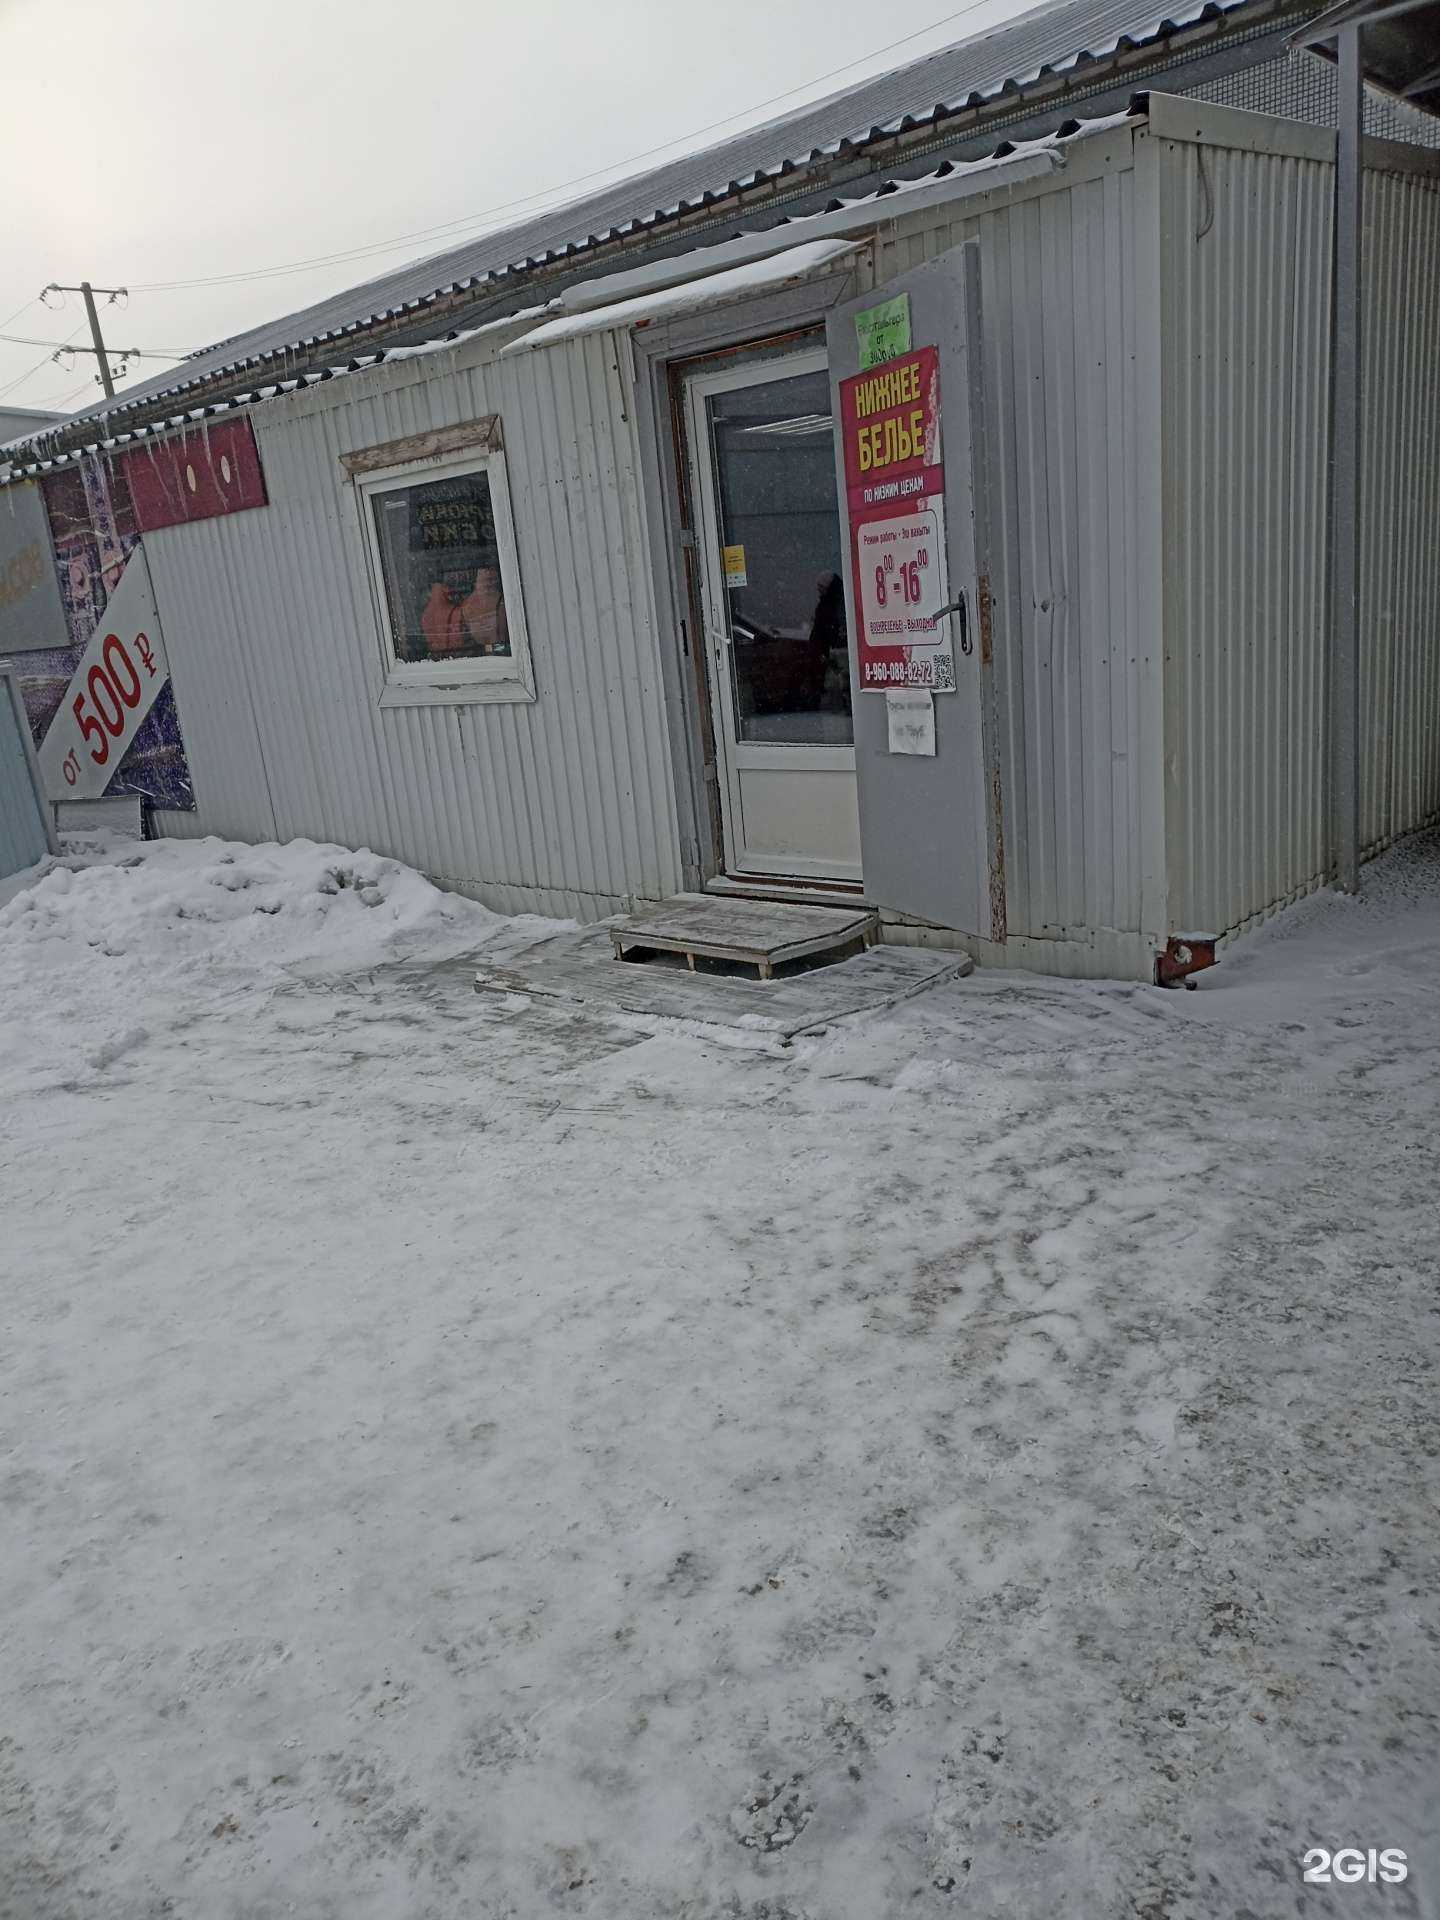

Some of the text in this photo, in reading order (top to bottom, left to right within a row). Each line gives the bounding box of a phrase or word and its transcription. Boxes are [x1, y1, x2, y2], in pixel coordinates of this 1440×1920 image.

[855, 363, 921, 419] НИЖНЕЕ
[857, 409, 925, 471] БЕЛЬЕ
[864, 476, 924, 503] ПО НИЗКИМ ЦЕНАМ
[880, 531, 897, 545] работы
[72, 633, 142, 766] 500
